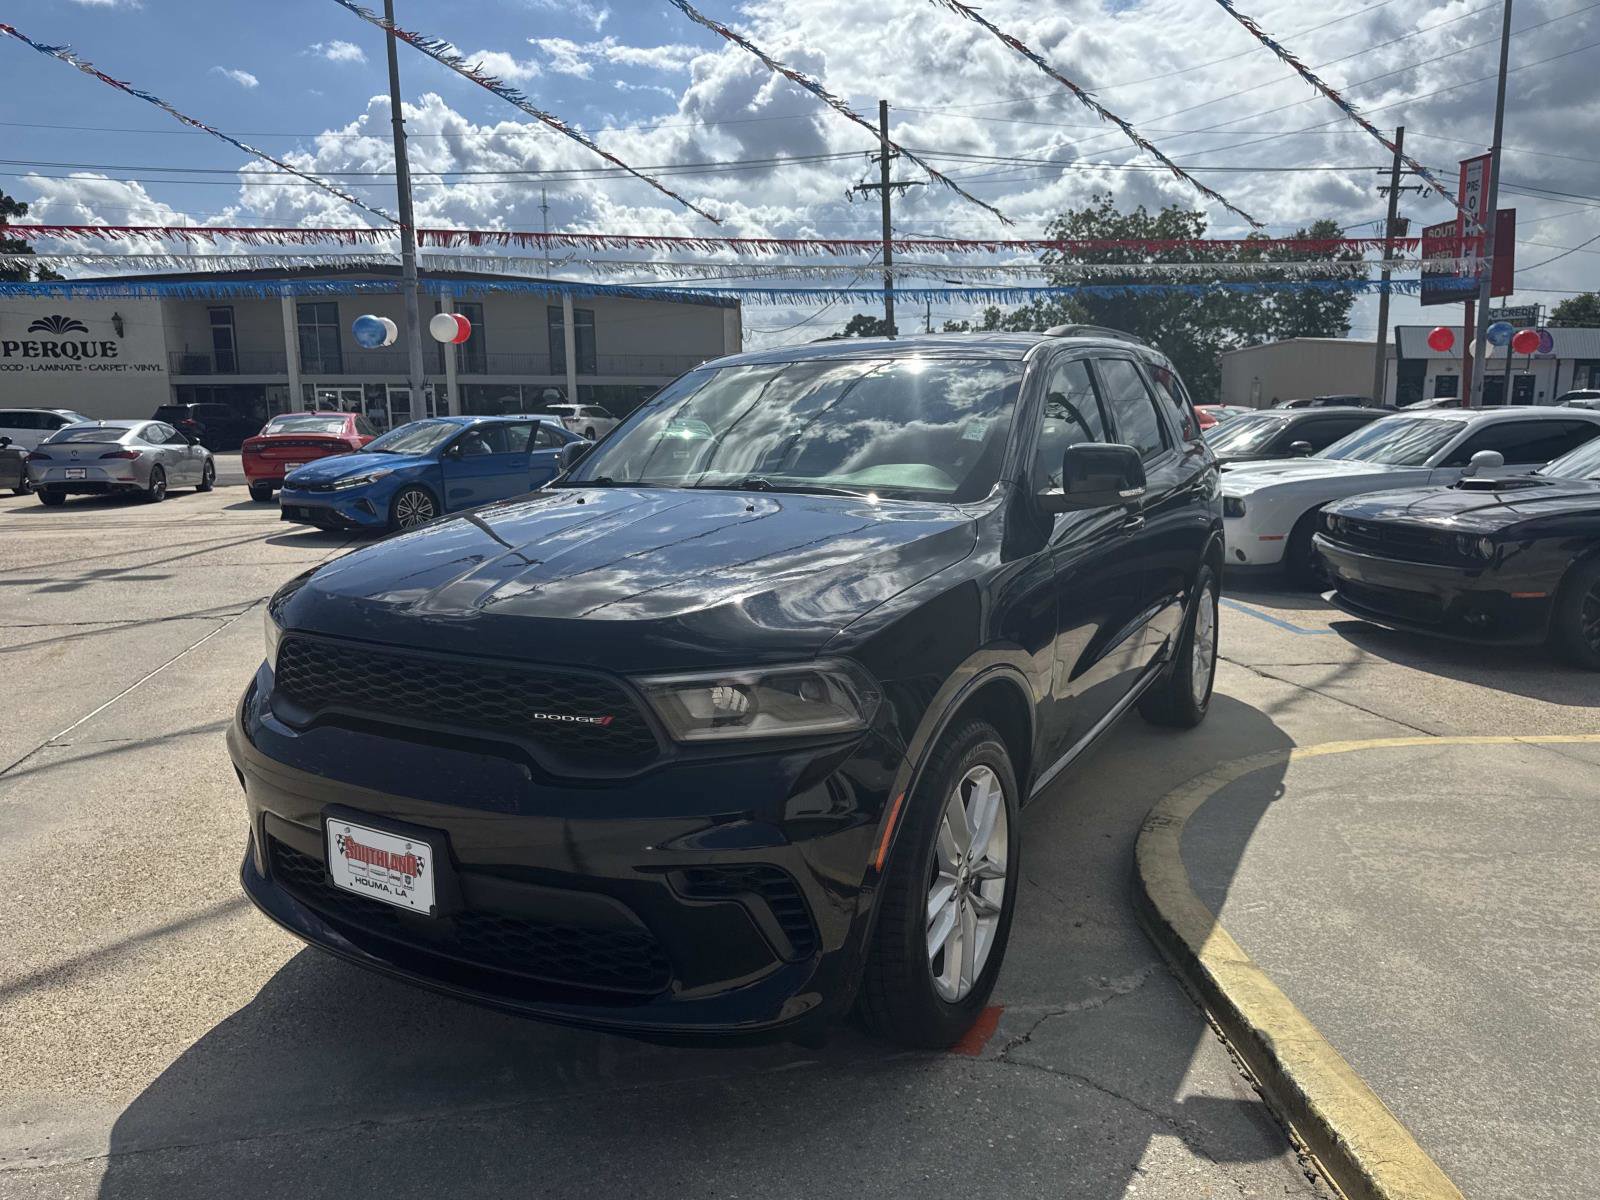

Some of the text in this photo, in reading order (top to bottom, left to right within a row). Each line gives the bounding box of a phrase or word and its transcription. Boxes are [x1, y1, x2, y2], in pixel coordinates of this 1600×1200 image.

[1, 340, 118, 360] PERQUE
[89, 363, 128, 371] CARPET
[534, 713, 603, 725] DODGE
[355, 876, 392, 895] HOUMA,
[395, 887, 408, 898] LA
